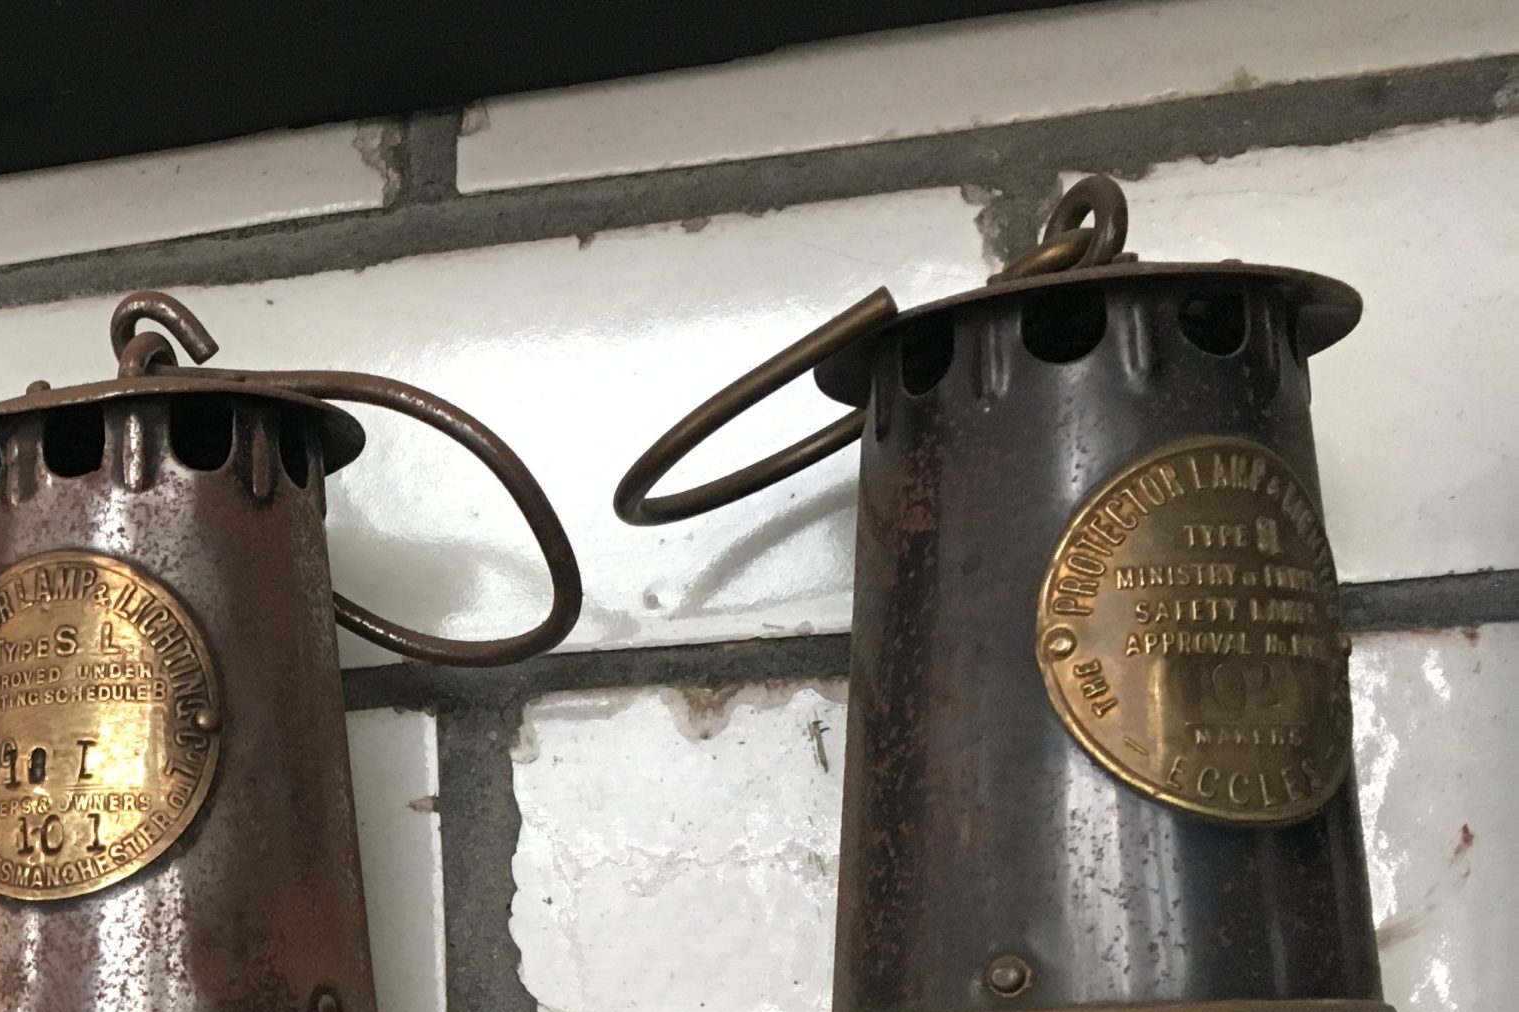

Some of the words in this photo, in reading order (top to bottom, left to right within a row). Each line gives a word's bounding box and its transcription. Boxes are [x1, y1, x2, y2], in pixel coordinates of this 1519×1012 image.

[1188, 453, 1267, 493] LAMP
[1052, 465, 1186, 618] PROTECTOR
[1183, 523, 1249, 548] TYPE
[14, 567, 98, 607] LAMP
[1116, 564, 1237, 590] MINISTRY
[1134, 598, 1237, 623] SAFETY
[1124, 632, 1252, 658] APPROVAL
[76, 661, 153, 681] UNDER
[44, 680, 148, 705] SCHEDULE
[1074, 658, 1119, 718] THE
[1193, 728, 1302, 746] MAKERS
[1165, 755, 1325, 807] ECCLES
[13, 809, 173, 888] MANCHESTER
